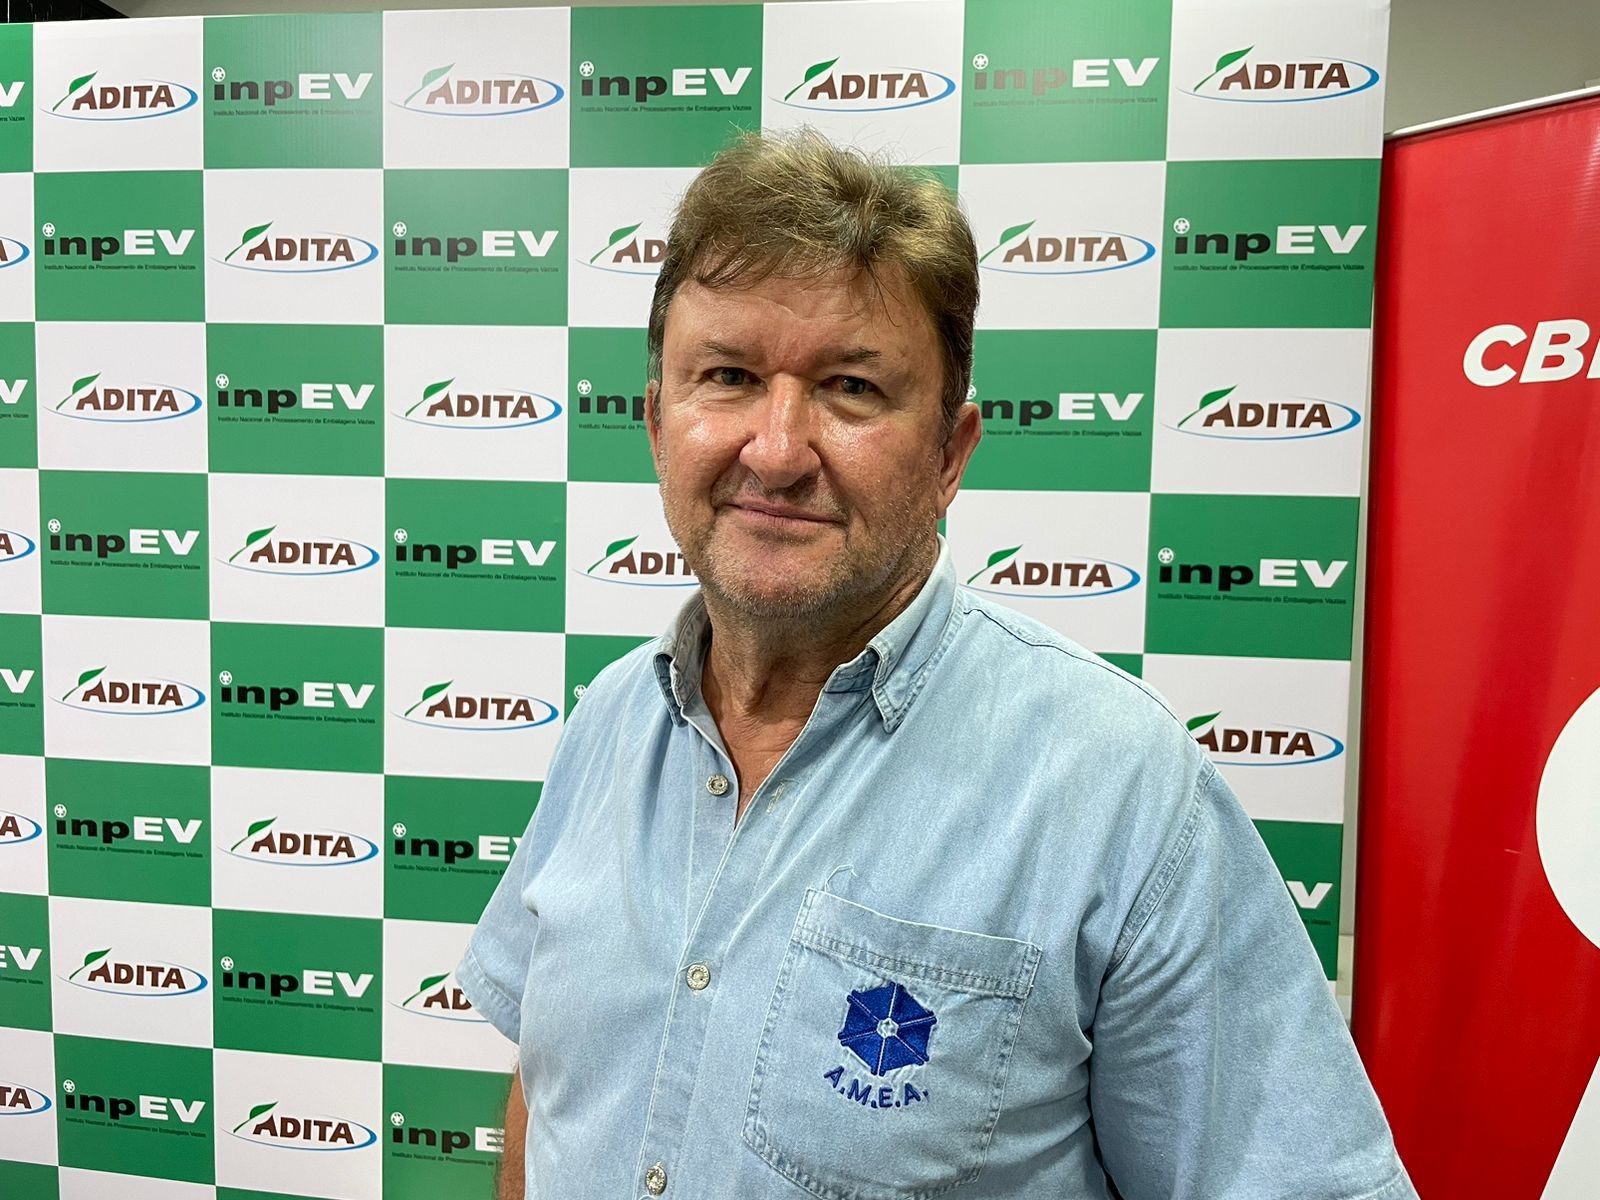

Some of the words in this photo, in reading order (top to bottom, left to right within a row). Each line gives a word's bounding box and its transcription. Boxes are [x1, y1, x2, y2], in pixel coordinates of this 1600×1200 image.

[212, 66, 373, 106] inpEV
[579, 61, 752, 102] inpEV
[809, 72, 927, 101] ADITA
[972, 54, 1159, 96] inpEV
[1219, 63, 1350, 91] ADITA
[72, 84, 175, 111] ADITA
[427, 79, 540, 104] ADITA
[694, 105, 731, 113] Embalagens
[43, 222, 195, 261] inpEV
[245, 235, 354, 262] ADITA
[393, 221, 559, 263] inpEV
[1003, 235, 1127, 262] ADITA
[1173, 218, 1367, 260] inpEV
[503, 266, 539, 274] Embalagens
[1300, 264, 1342, 272] Embalagens
[1463, 319, 1600, 387] CB
[76, 387, 179, 412] ADITA
[216, 374, 375, 413] inpEV
[427, 392, 537, 419] ADITA
[322, 418, 357, 426] Embalagens
[980, 391, 1144, 426] npEV
[1203, 401, 1333, 429] ADITA
[48, 519, 200, 558] inpEV
[250, 538, 355, 566] ADITA
[394, 528, 557, 570] inpEV
[150, 563, 183, 571] Embalagens
[450, 572, 494, 580] Processamento
[502, 574, 538, 582] Embalagens
[609, 549, 691, 576] ADIT
[991, 559, 1113, 588] ADITA
[1158, 548, 1348, 592] inpEV
[82, 679, 183, 706] ADITA
[219, 671, 375, 711] inpEV
[427, 694, 535, 722] ADITA
[1196, 727, 1315, 757] ADITA
[55, 804, 203, 844] inpEV
[251, 830, 355, 858] ADITA
[393, 823, 522, 864] inpE
[88, 961, 186, 989] ADITA
[221, 957, 374, 998] inpEV
[63, 1079, 206, 1124] inpEV
[824, 1066, 929, 1108] A.M.E.A.
[253, 1113, 355, 1145] ADITA
[391, 1112, 504, 1154] inpE
